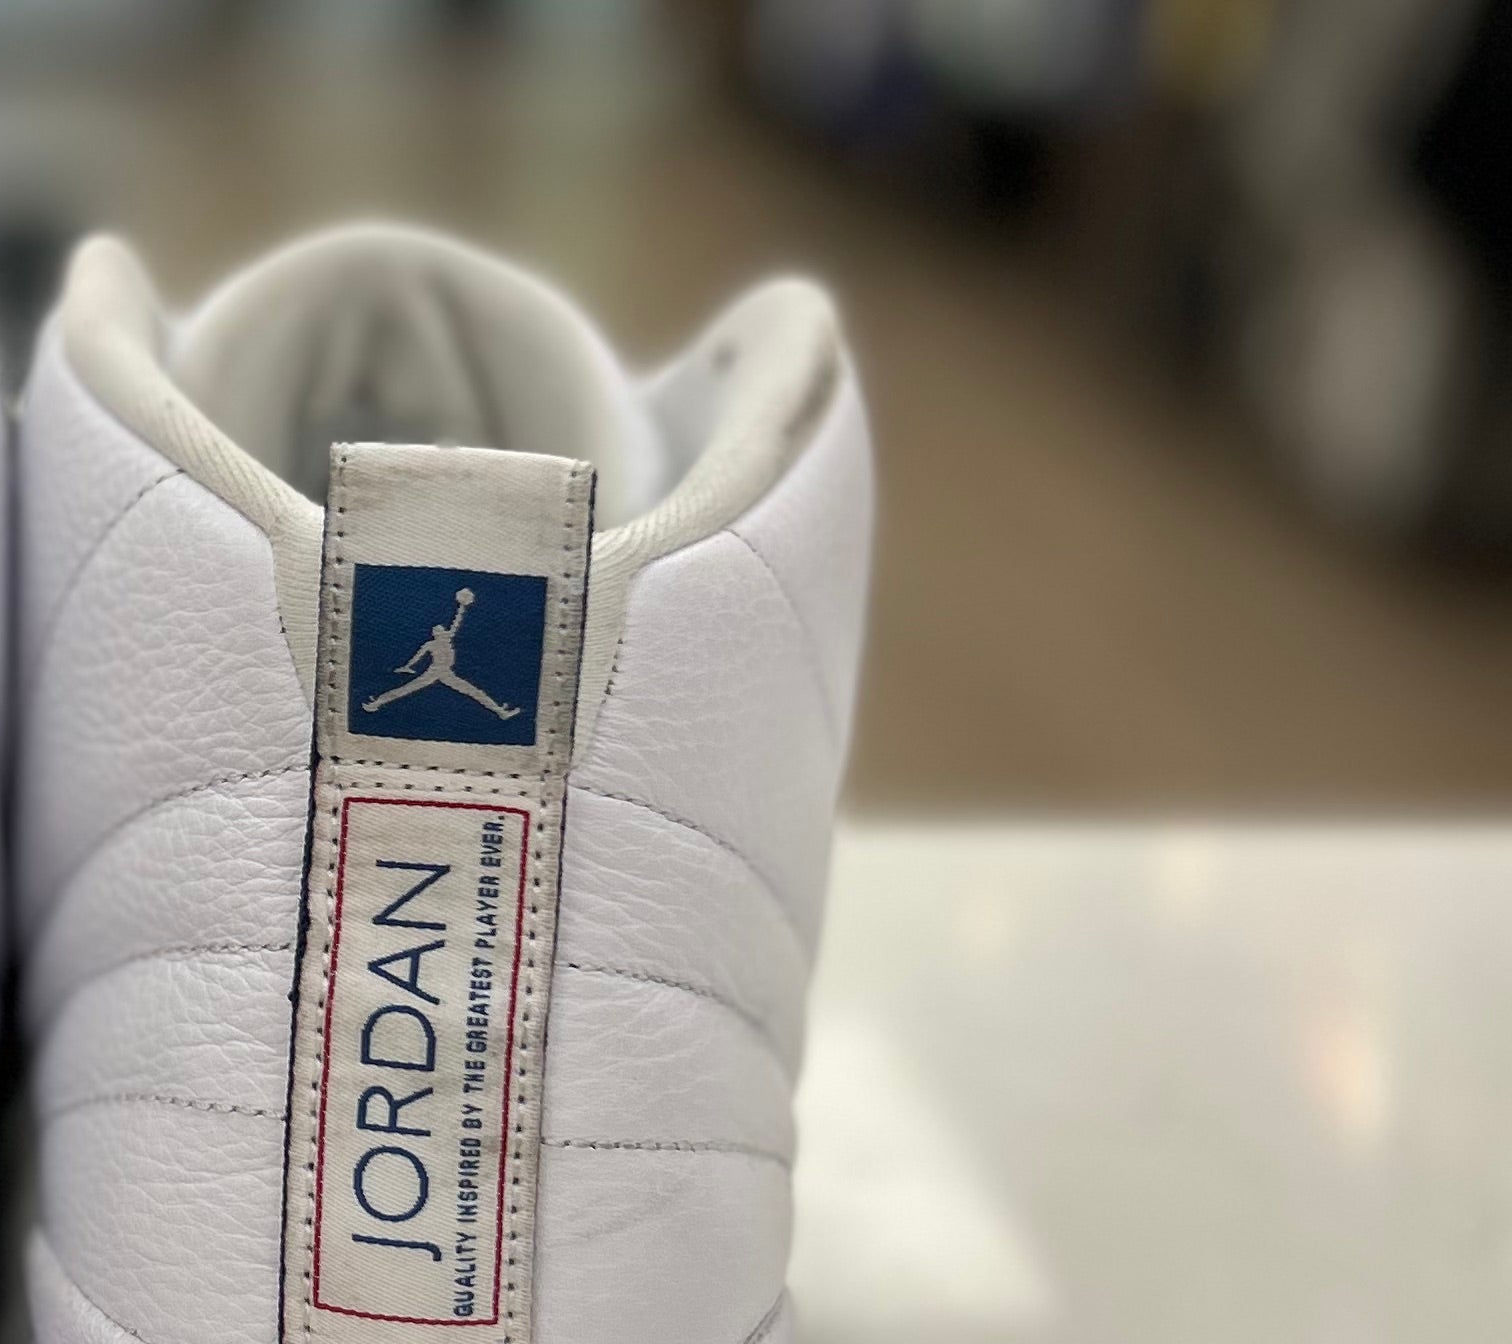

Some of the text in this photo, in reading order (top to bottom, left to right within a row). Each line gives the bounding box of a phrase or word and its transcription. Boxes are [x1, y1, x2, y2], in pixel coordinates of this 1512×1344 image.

[351, 859, 451, 1262] JORDAN
[453, 815, 505, 1316] QUALITY INSPIRED BY THE GREATEST PLAYER EVER.
